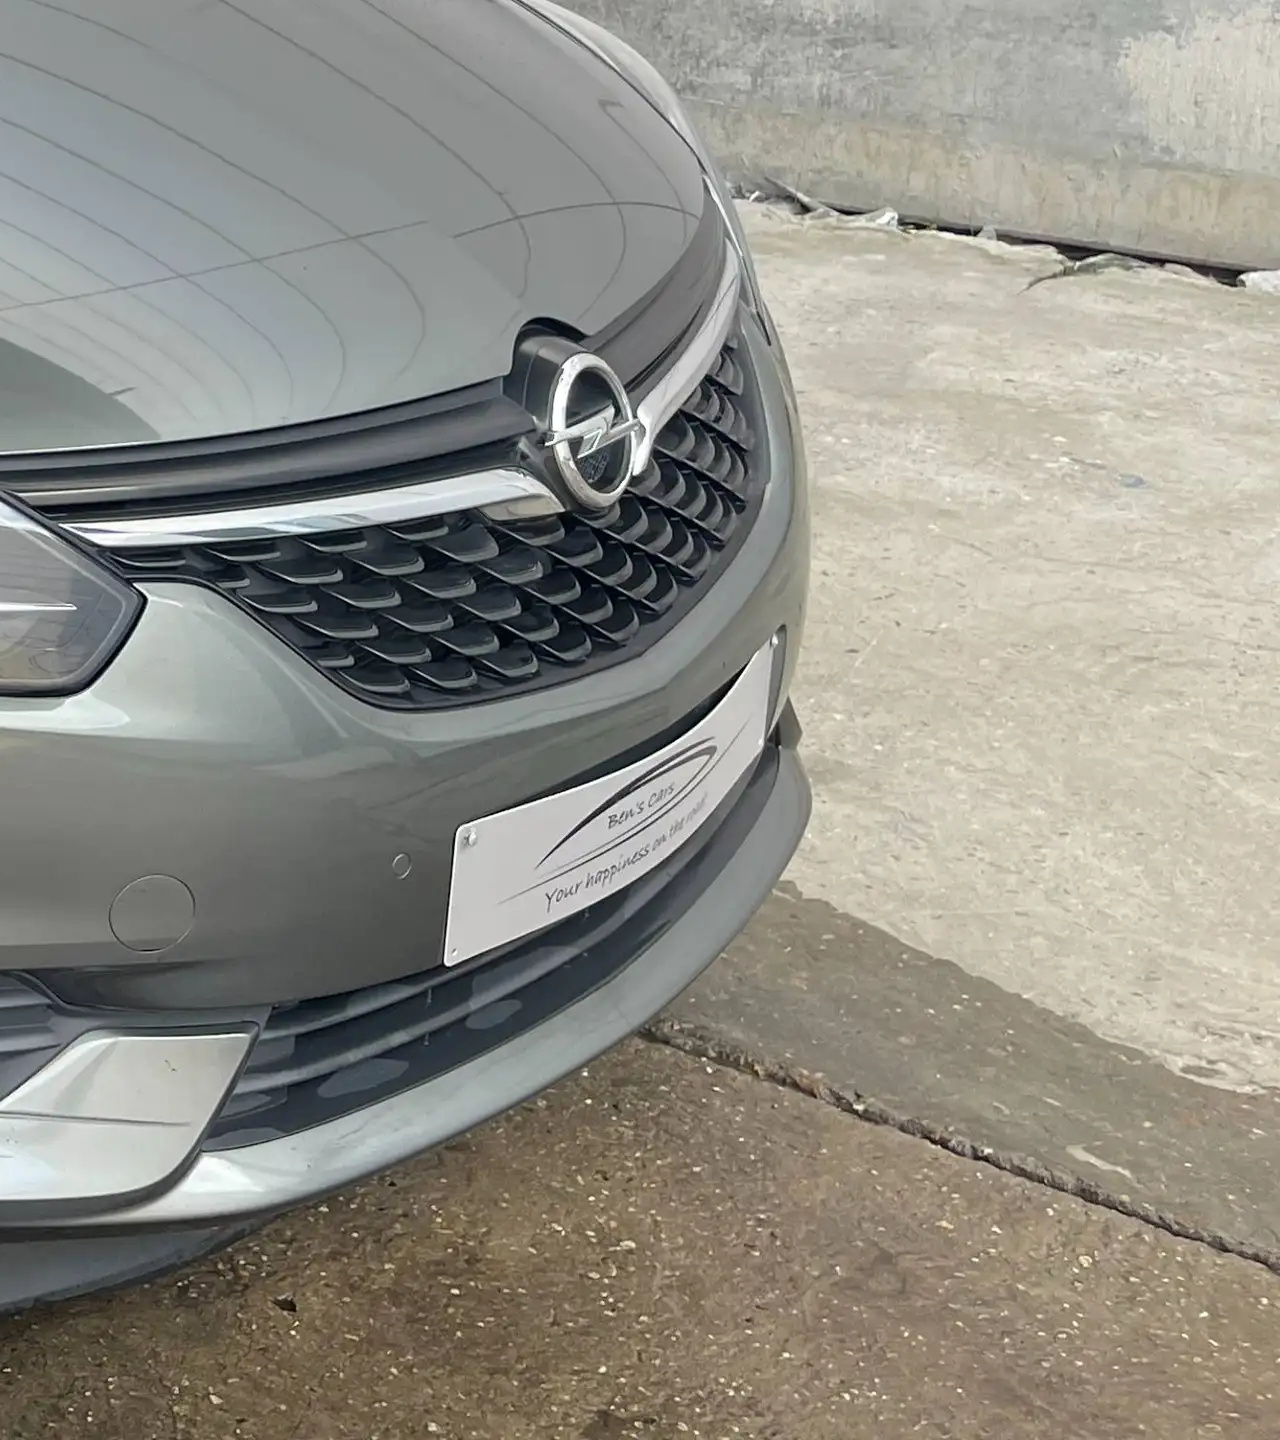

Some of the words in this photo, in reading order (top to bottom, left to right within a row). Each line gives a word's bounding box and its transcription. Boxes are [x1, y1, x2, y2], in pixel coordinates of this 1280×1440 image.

[607, 799, 645, 831] Ben's
[544, 880, 583, 914] Your
[585, 843, 650, 889] happiness
